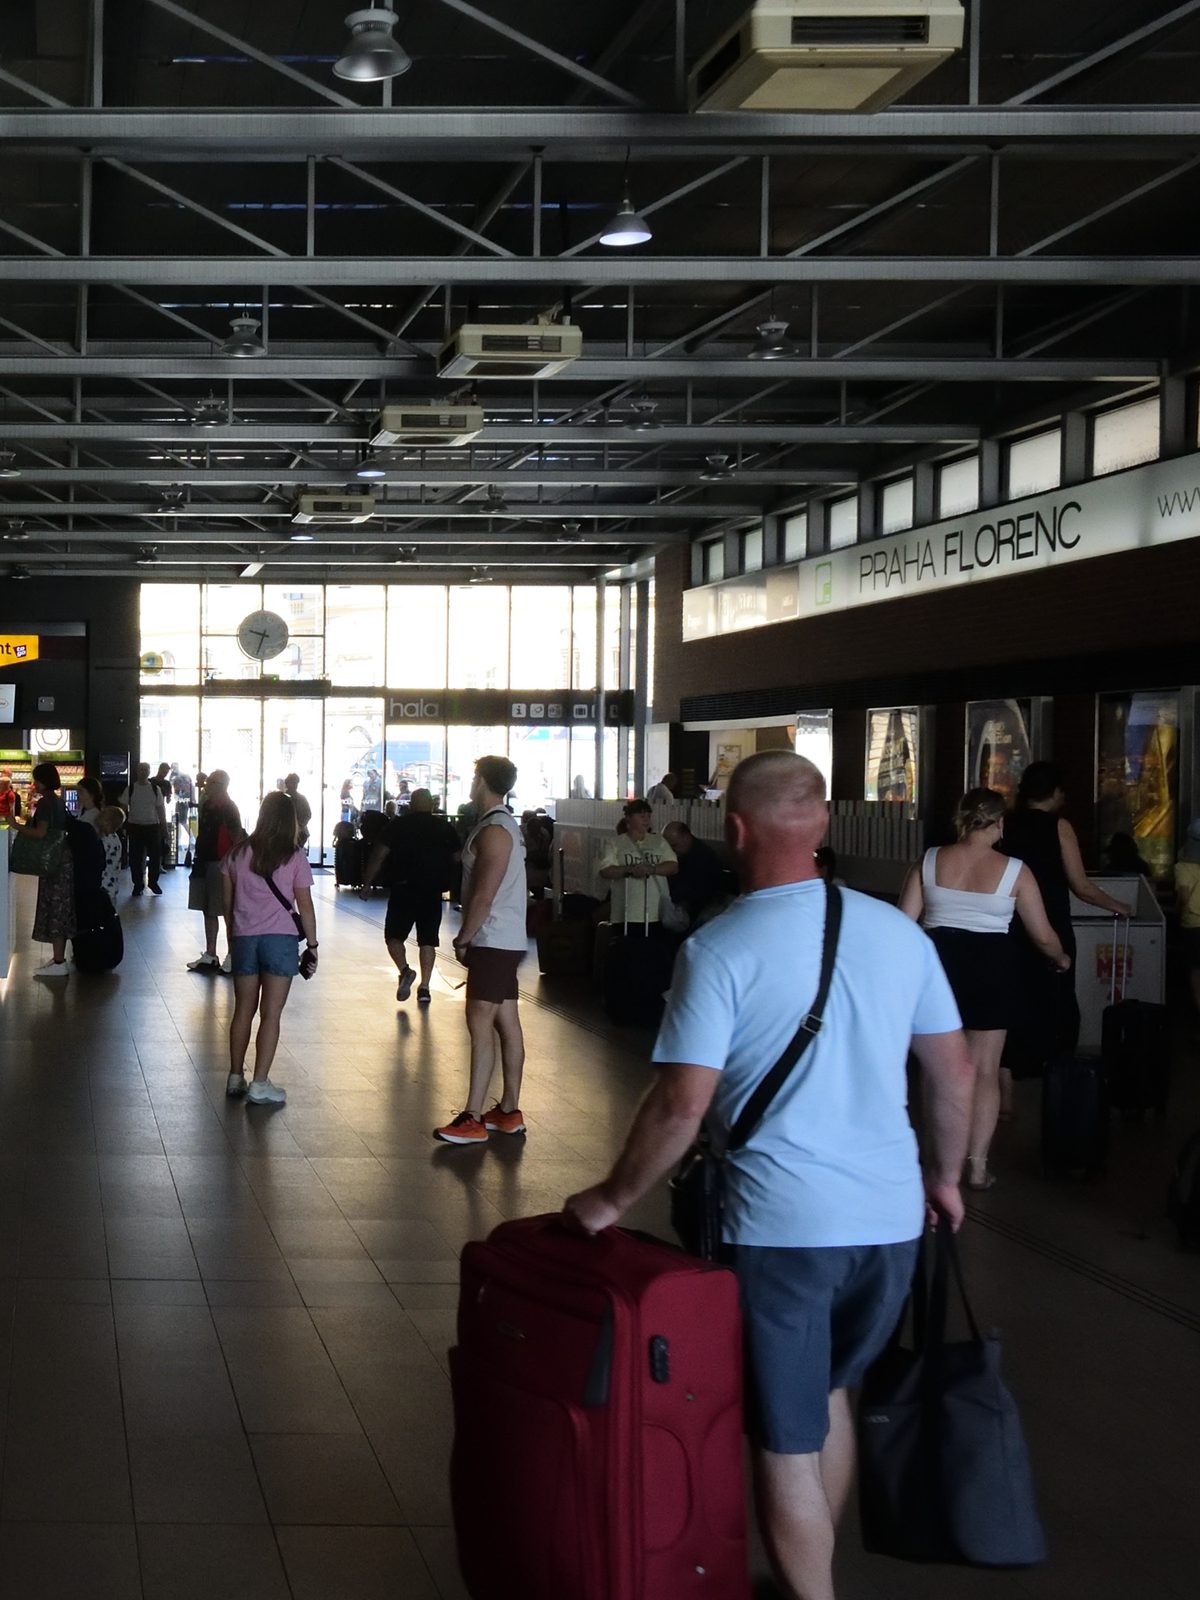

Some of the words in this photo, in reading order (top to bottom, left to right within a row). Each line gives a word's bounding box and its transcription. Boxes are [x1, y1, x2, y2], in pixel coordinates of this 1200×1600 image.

[859, 538, 936, 593] PRAHA
[943, 501, 1083, 576] FLORENC
[390, 697, 440, 718] hala
